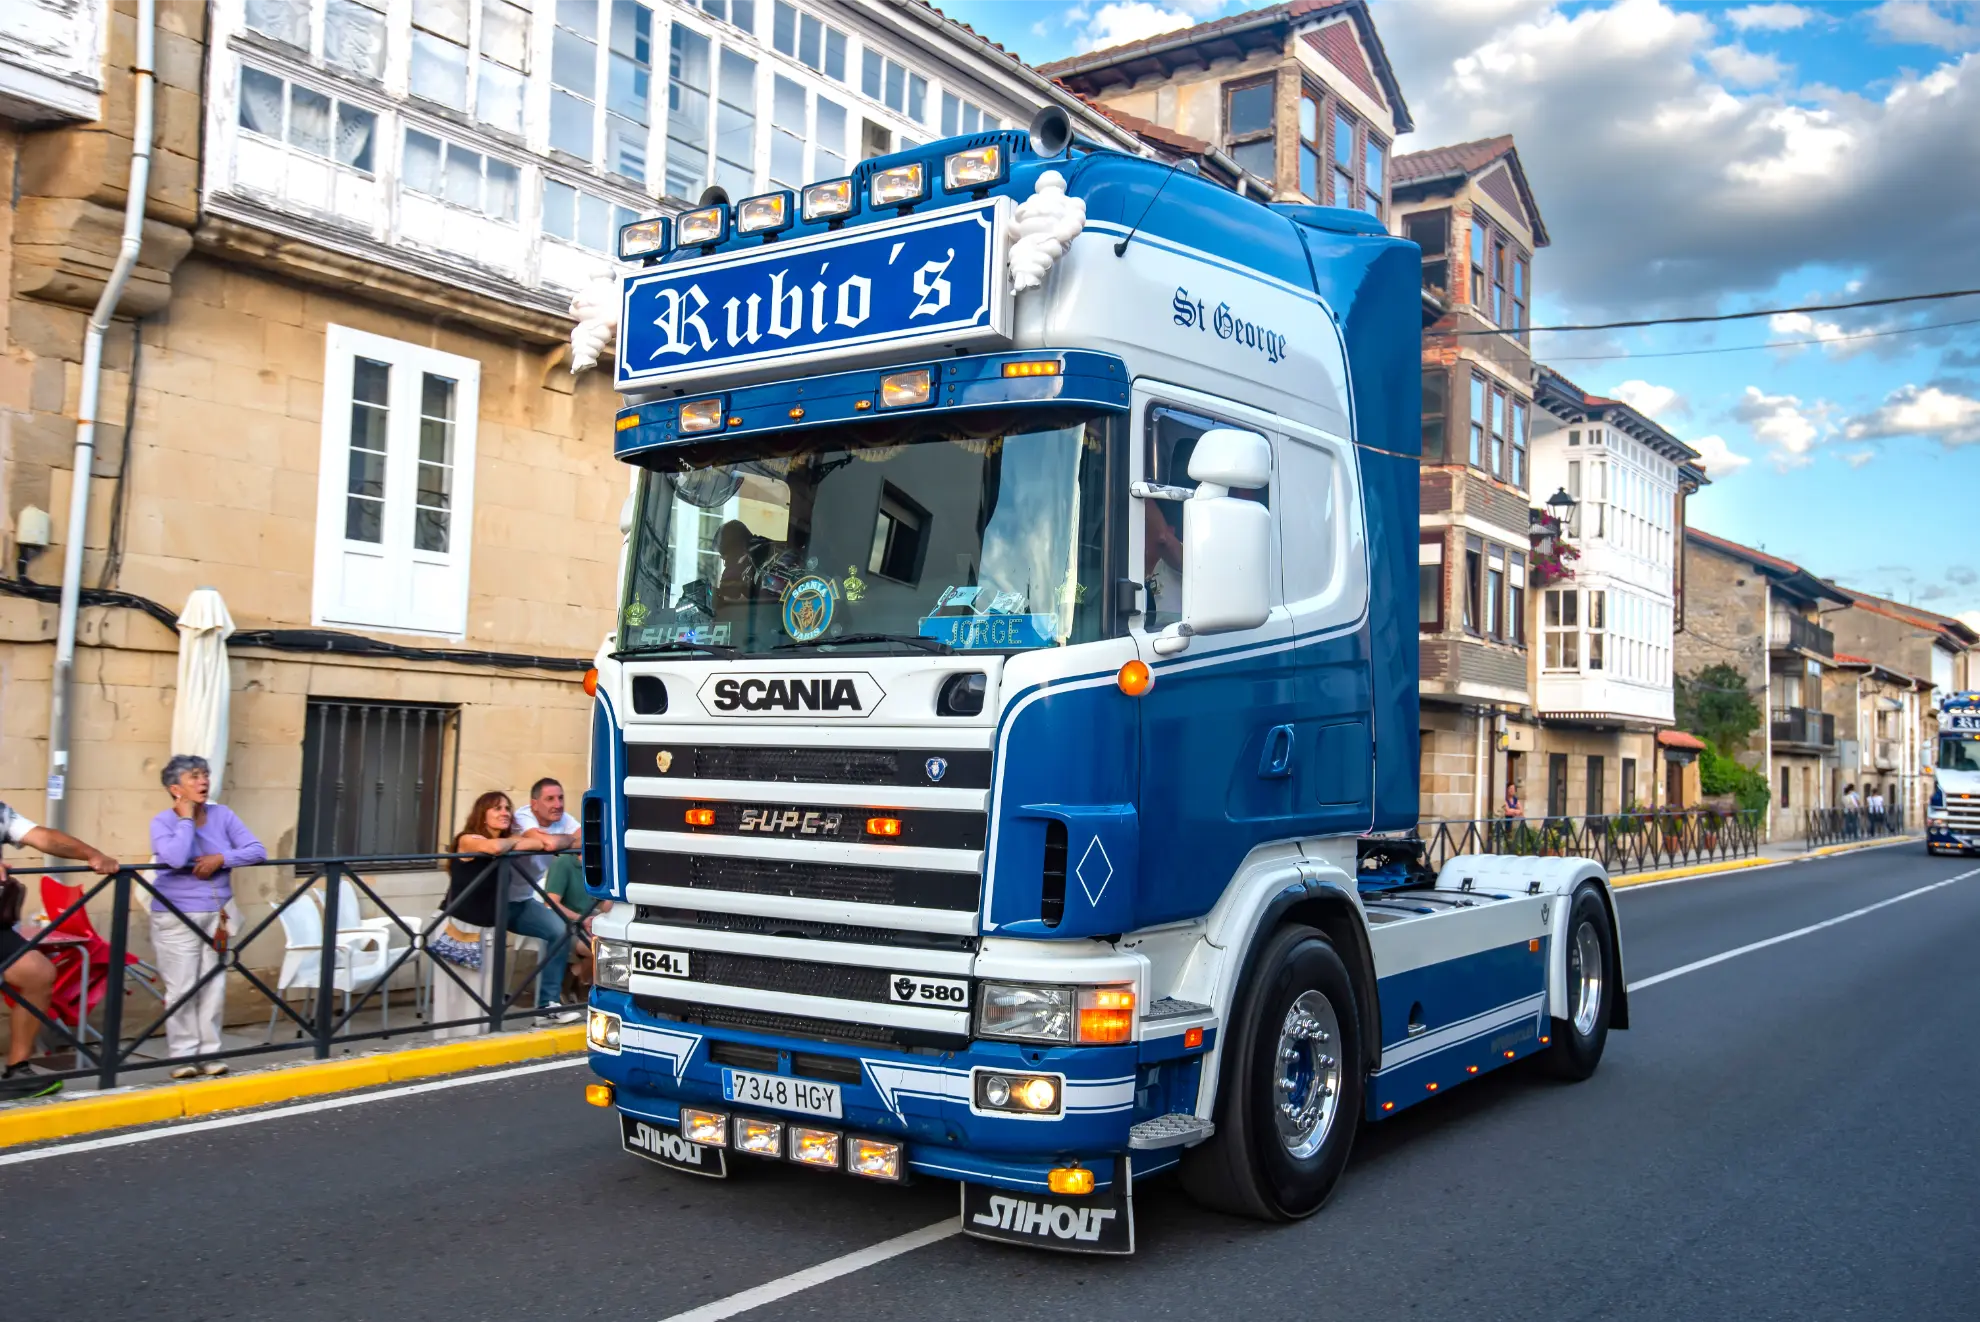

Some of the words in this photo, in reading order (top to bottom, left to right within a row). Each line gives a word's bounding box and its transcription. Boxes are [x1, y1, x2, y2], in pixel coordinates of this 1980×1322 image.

[1172, 286, 1206, 332] St
[1213, 301, 1287, 364] George
[792, 579, 828, 599] SCANIA
[945, 618, 1023, 645] JORGE
[713, 678, 863, 711] SCANIA
[738, 809, 843, 835] SUPER
[920, 984, 965, 1003] 580
[735, 1074, 788, 1105] 7348
[794, 1083, 834, 1112] HGY
[629, 1121, 708, 1165] STIHOLT
[972, 1195, 1117, 1241] STIHOLT
